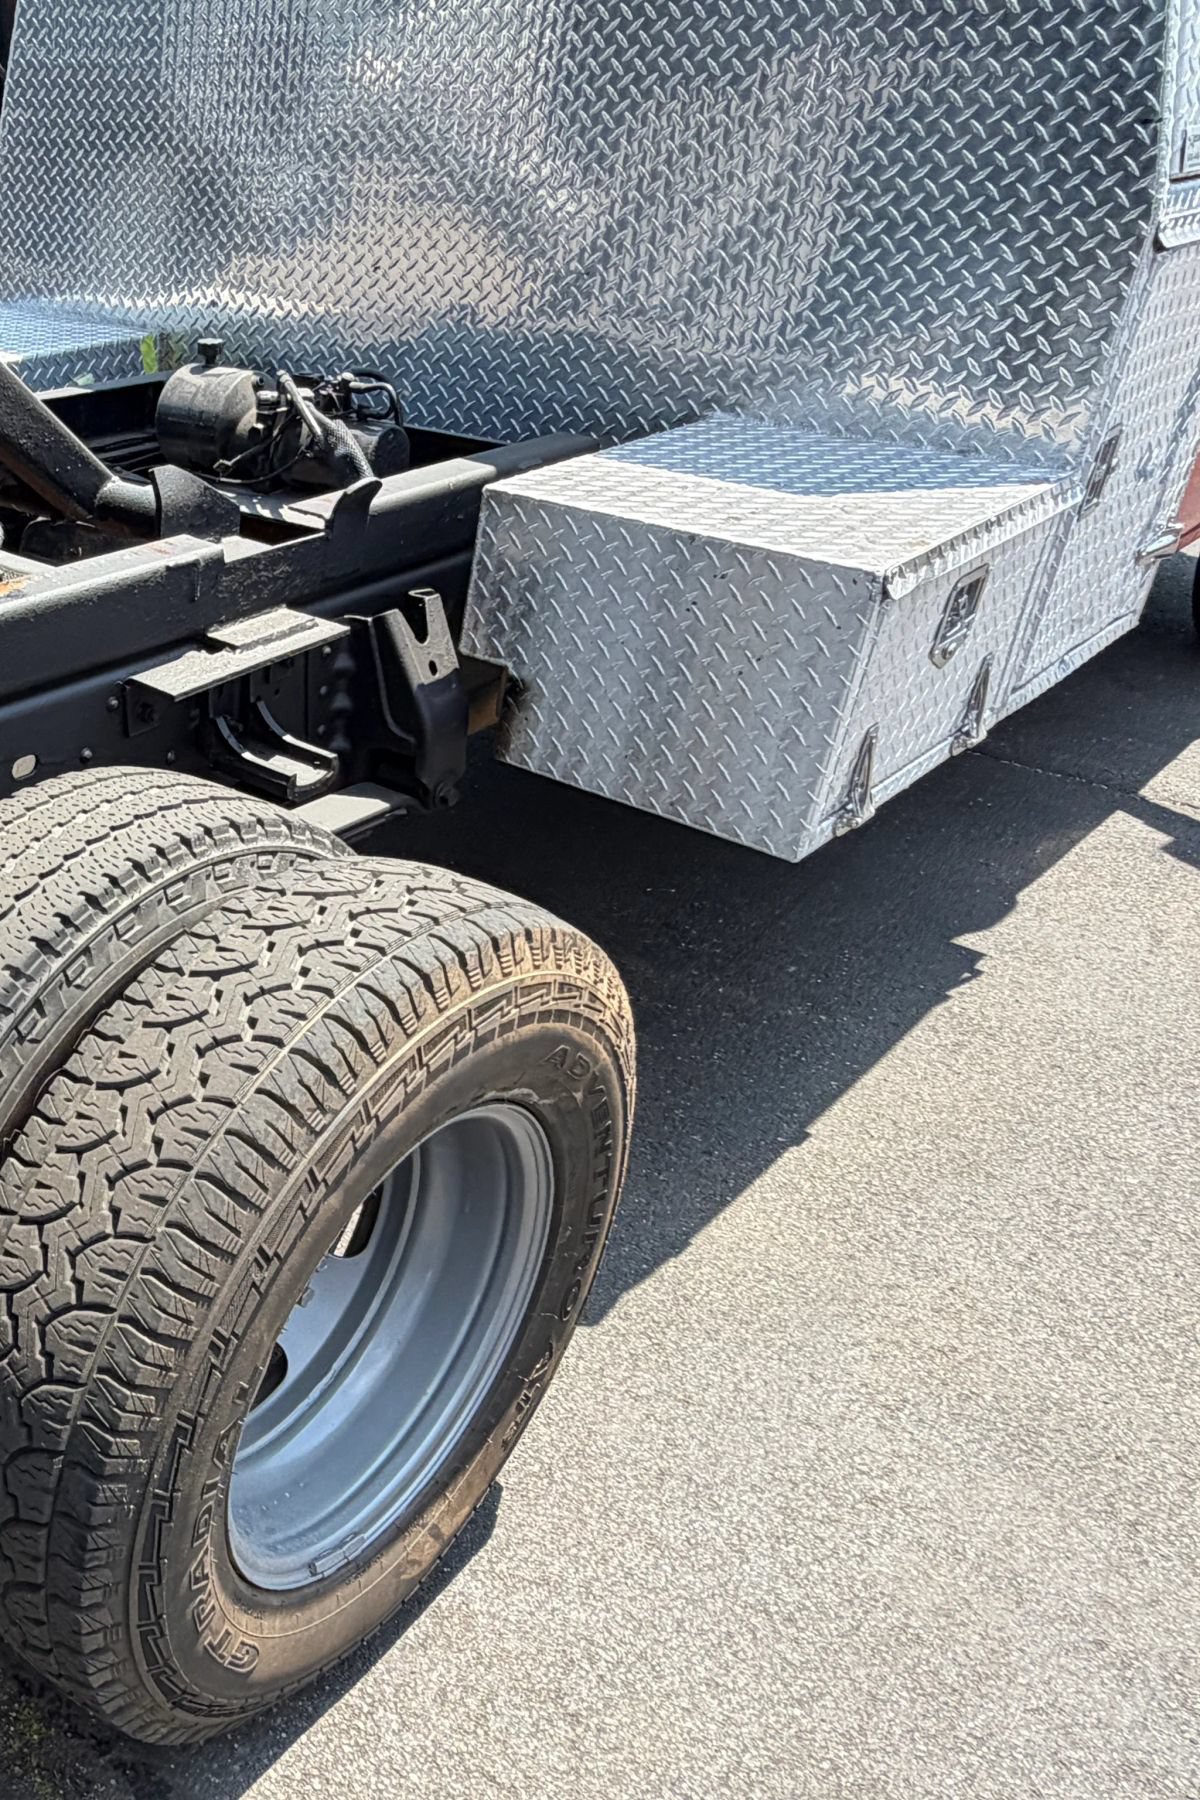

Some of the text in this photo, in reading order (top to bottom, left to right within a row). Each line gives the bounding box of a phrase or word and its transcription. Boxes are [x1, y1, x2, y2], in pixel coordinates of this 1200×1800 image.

[541, 1043, 613, 1322] ADVENTURO
[189, 1365, 264, 1634] RADIAL
[203, 1627, 261, 1674] GT
